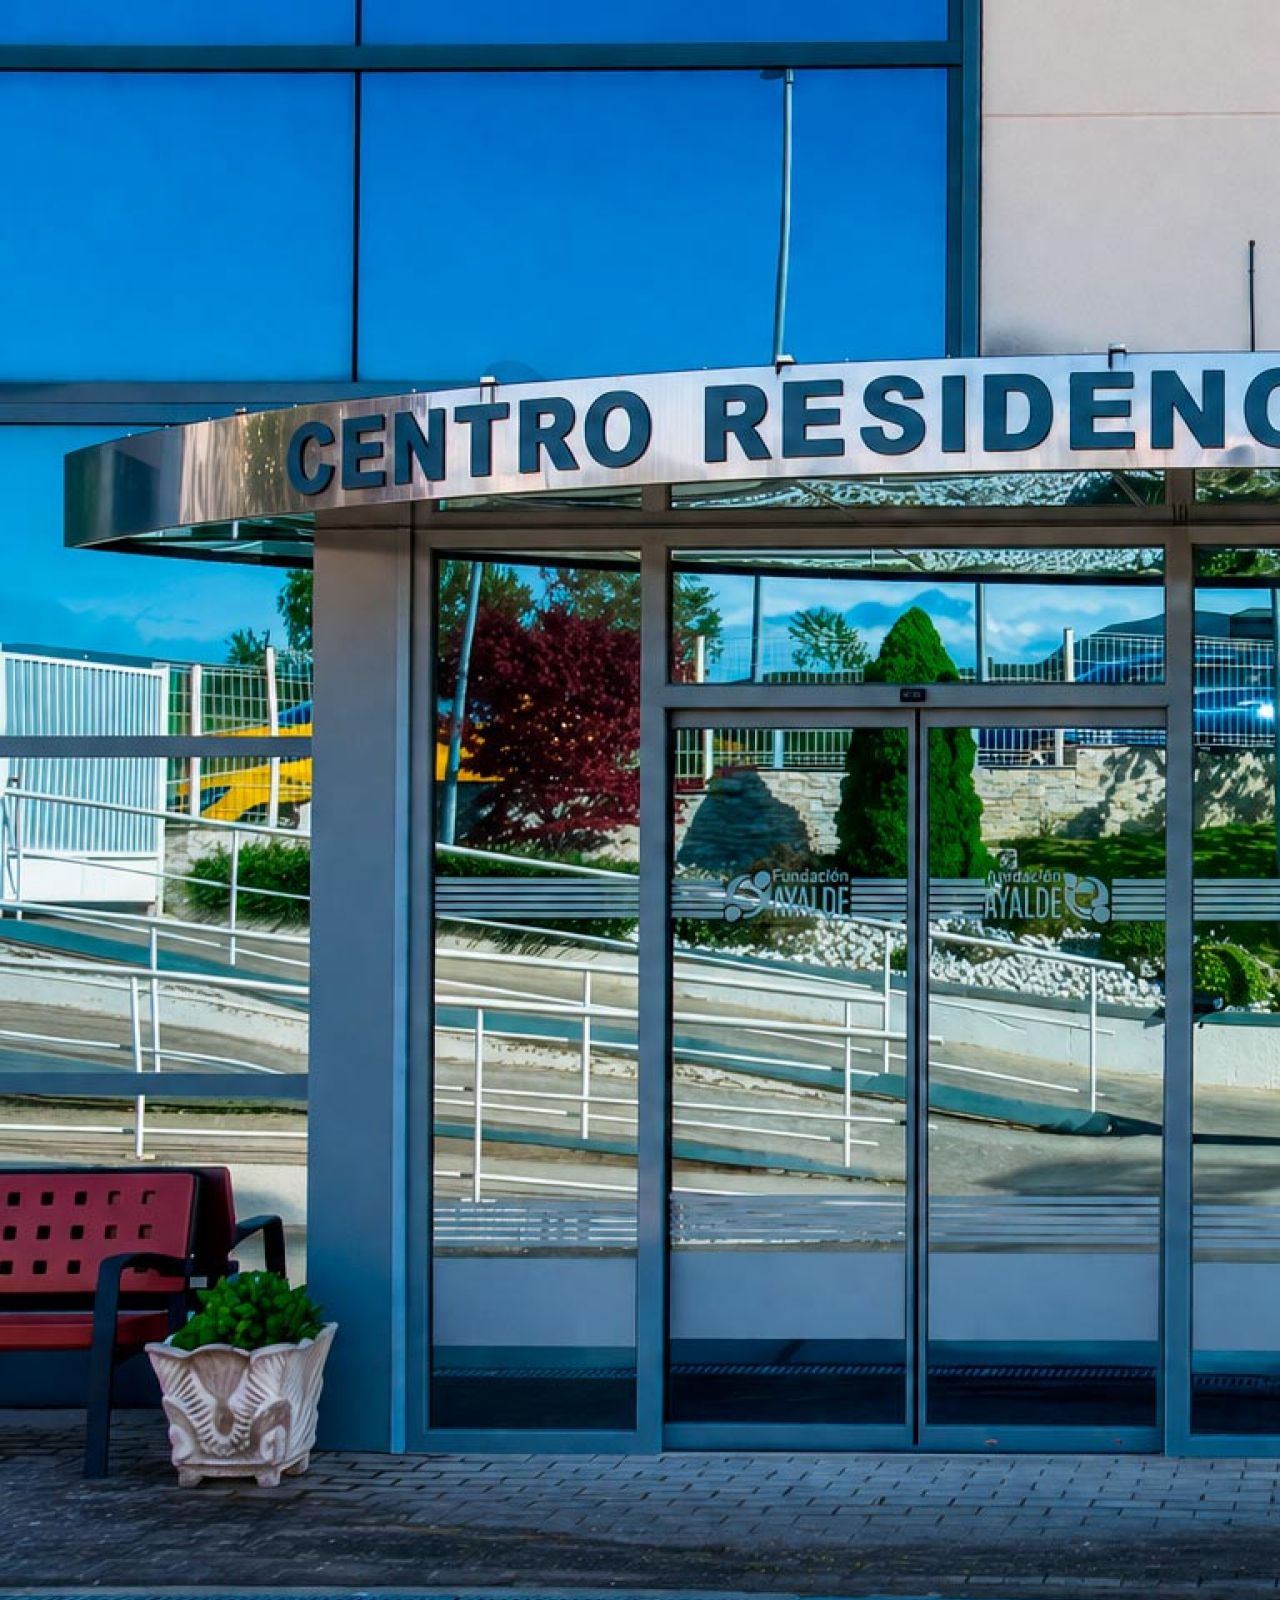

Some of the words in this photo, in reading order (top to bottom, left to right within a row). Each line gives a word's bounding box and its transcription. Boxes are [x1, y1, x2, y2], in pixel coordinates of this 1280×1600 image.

[285, 389, 652, 496] CENTRO
[772, 867, 849, 882] Fundación
[774, 885, 850, 918] AYALDE
[984, 885, 1062, 919] AYALDE
